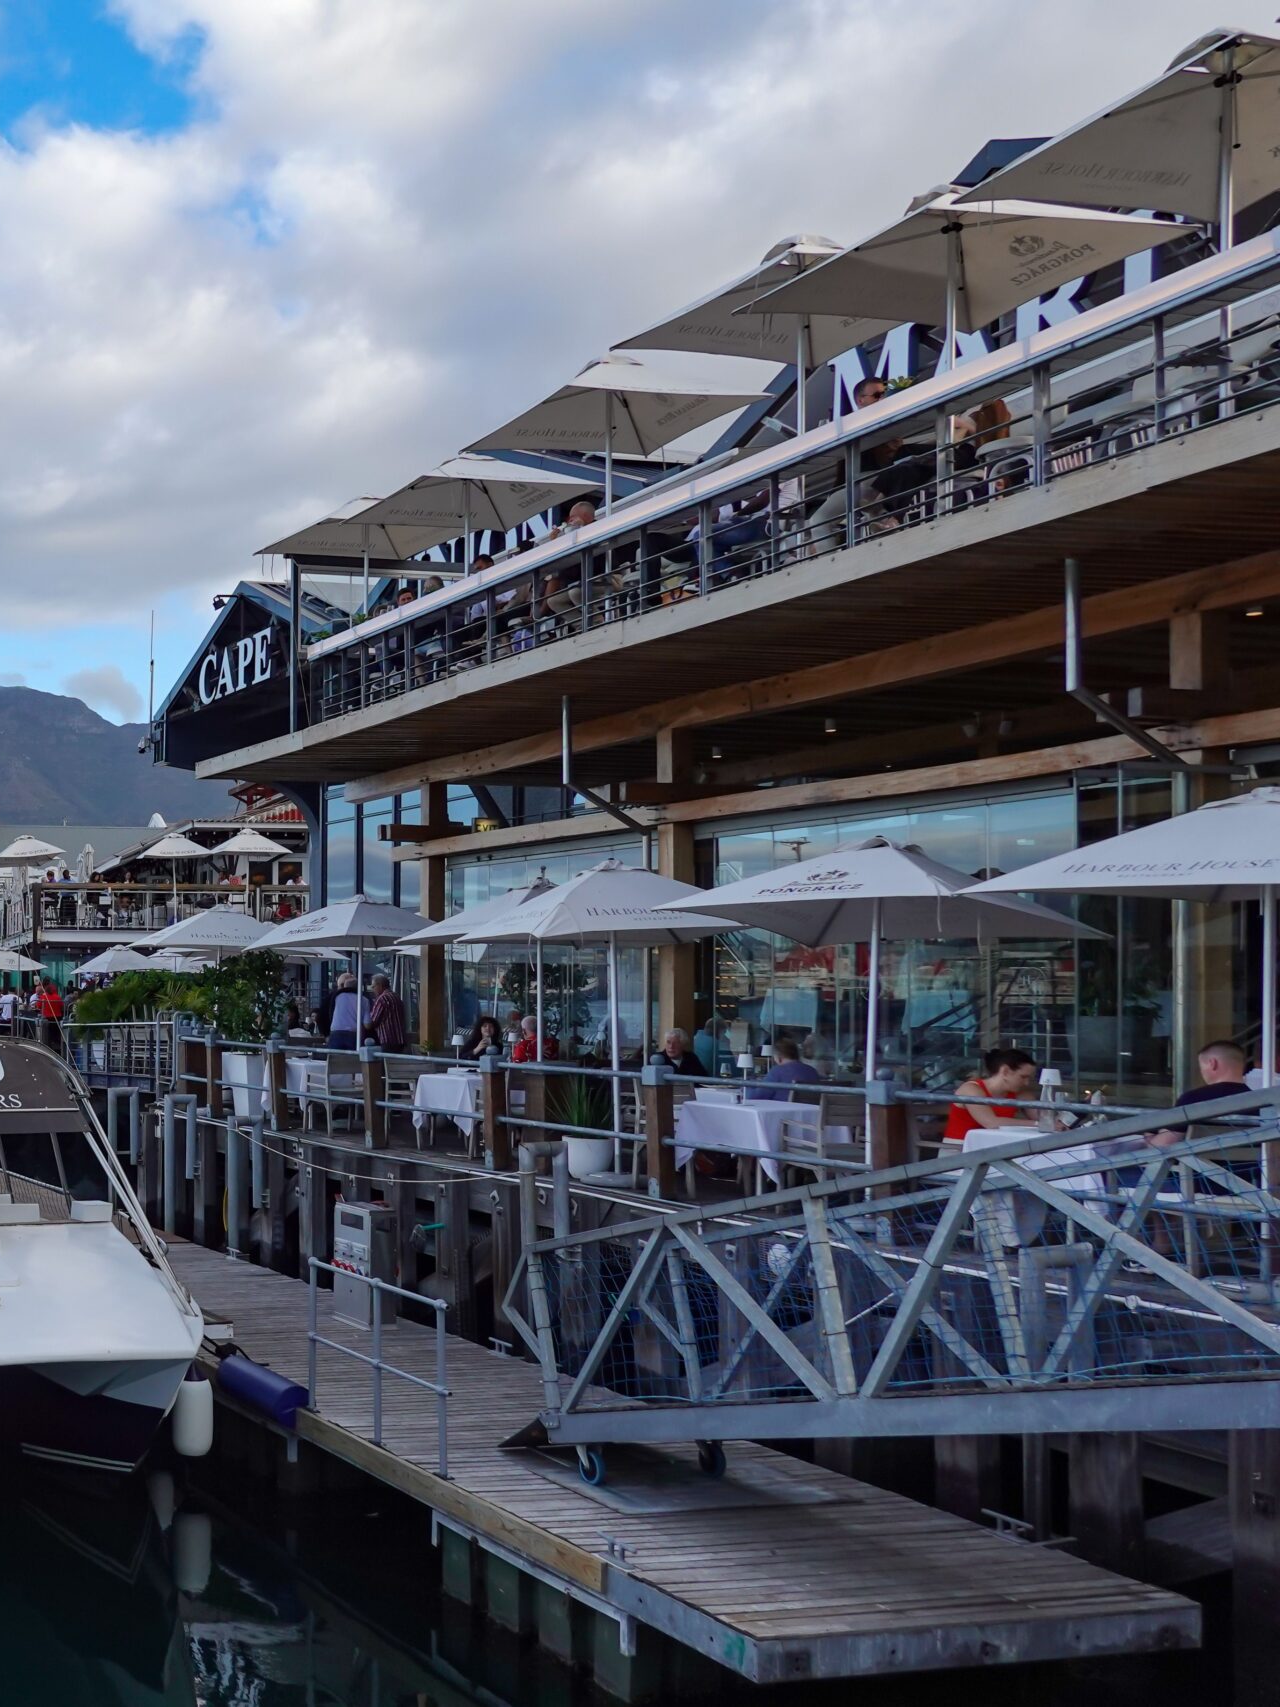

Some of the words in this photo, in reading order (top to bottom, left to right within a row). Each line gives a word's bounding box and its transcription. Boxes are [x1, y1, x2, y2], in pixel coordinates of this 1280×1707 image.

[198, 627, 271, 705] CAPE
[1062, 863, 1182, 874] HARBOUR
[1186, 858, 1278, 870] HOUSE
